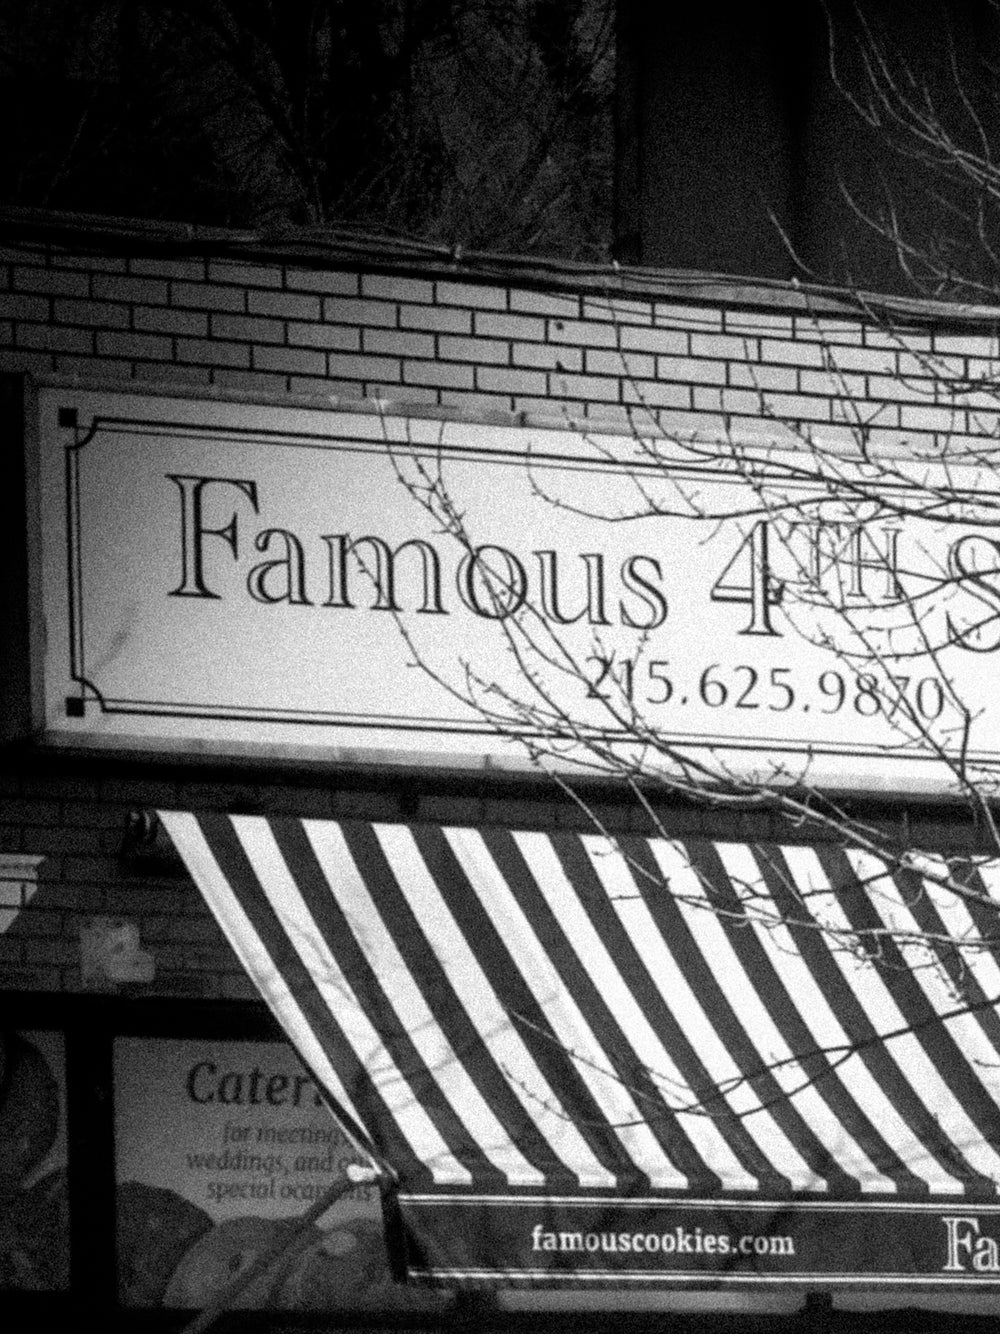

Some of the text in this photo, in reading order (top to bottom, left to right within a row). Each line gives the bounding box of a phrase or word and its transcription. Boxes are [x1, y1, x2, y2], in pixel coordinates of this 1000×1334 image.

[165, 473, 668, 630] Famous
[710, 519, 903, 637] 4TH
[585, 654, 945, 720] 215.625.9870
[186, 1061, 323, 1107] Cater
[294, 1149, 333, 1171] and
[206, 1180, 276, 1203] special
[530, 1224, 795, 1256] famouscookies.com
